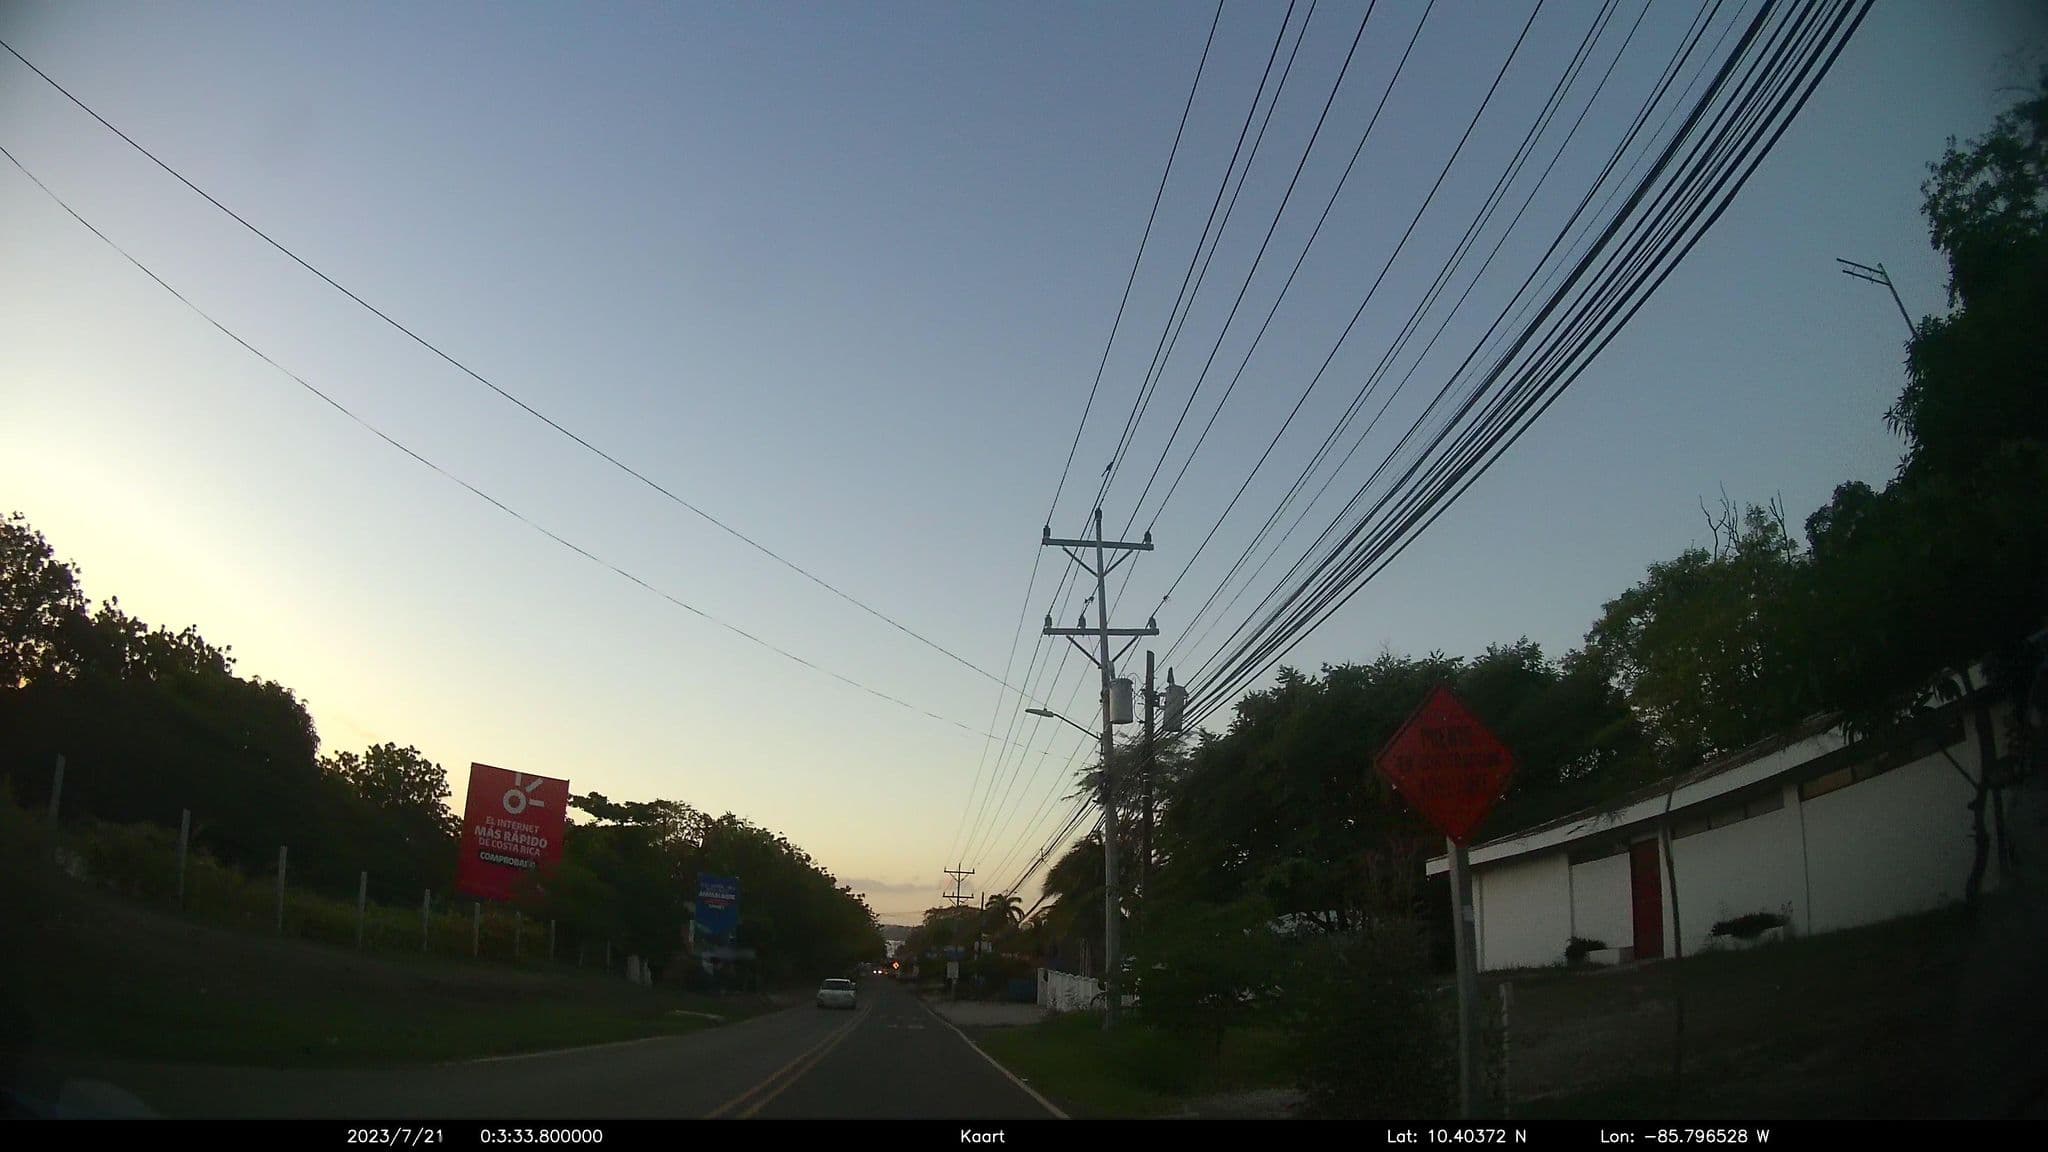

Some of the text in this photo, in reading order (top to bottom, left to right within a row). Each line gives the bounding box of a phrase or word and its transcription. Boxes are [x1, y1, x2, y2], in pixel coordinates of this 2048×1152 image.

[486, 816, 540, 833] EL INTERNET
[474, 825, 548, 849] MÁS RÁPIDO
[479, 837, 541, 857] DE COSTA RICA
